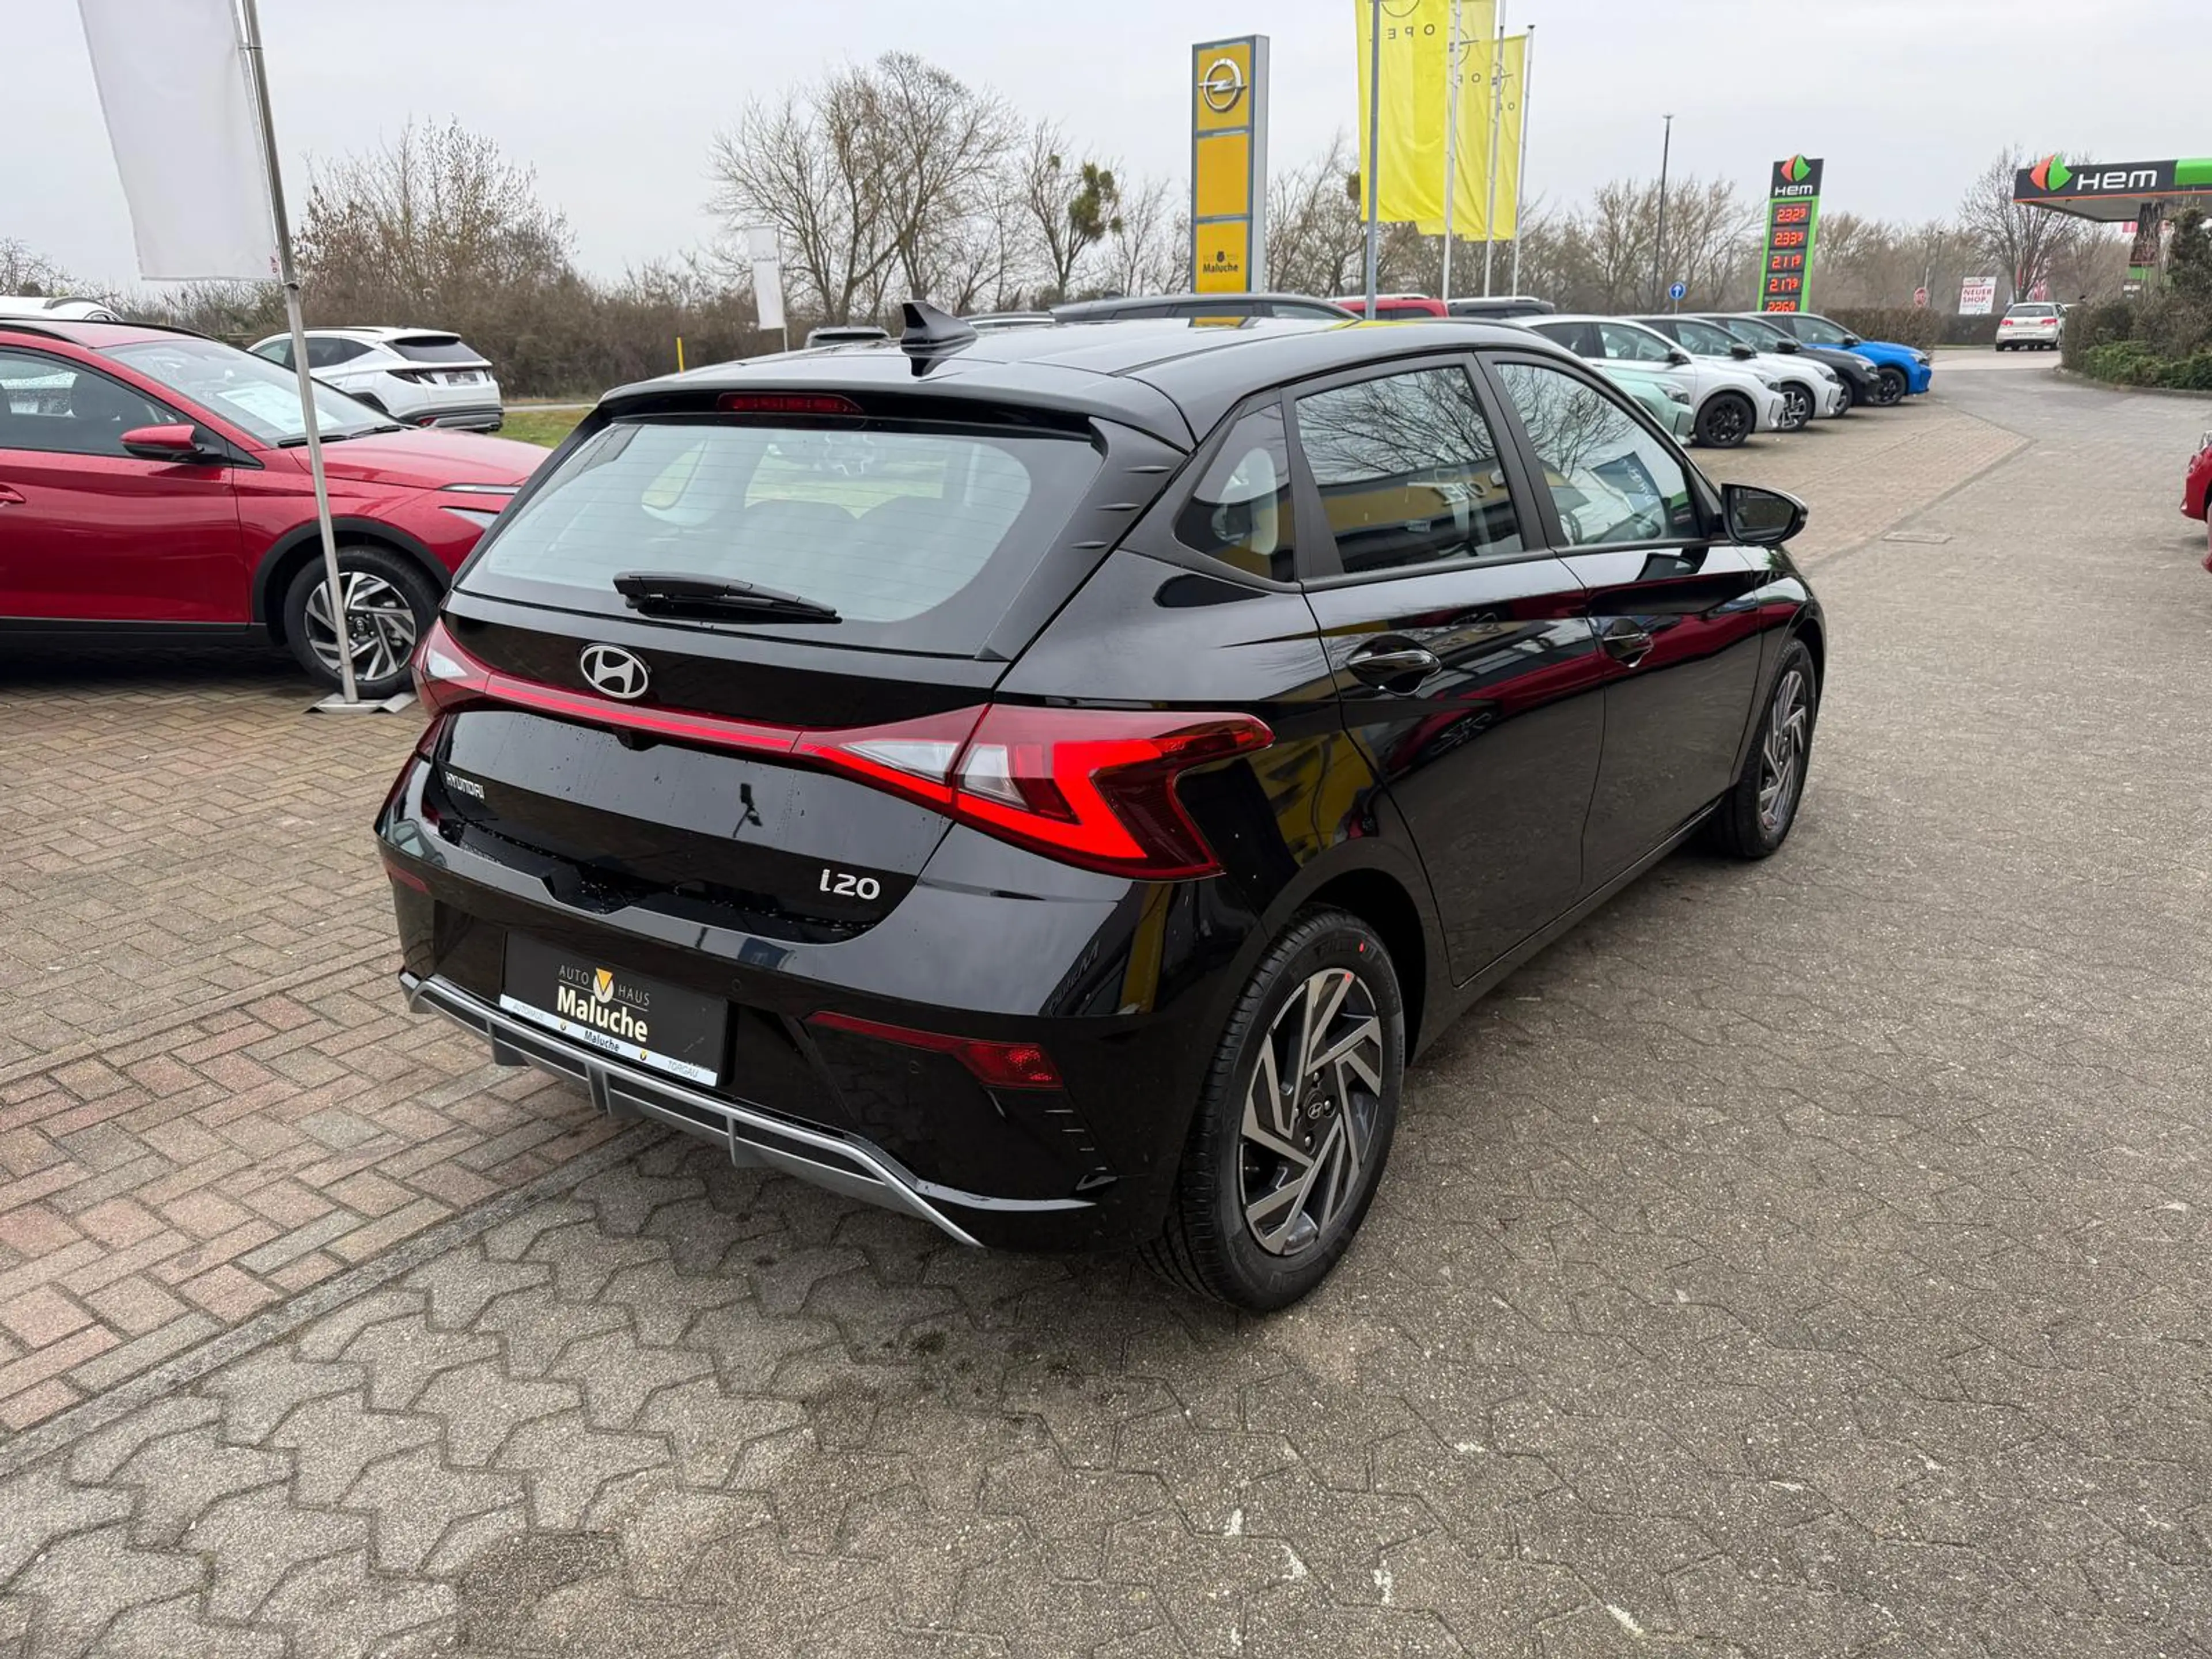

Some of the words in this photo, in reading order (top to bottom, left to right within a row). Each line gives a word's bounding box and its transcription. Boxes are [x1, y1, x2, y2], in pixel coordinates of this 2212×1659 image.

[445, 771, 485, 800] HYUNDAI
[559, 964, 589, 984] AUTO
[618, 987, 650, 1006] HAUS
[556, 986, 649, 1043] Maluche
[584, 1030, 620, 1052] Maluche
[667, 1060, 699, 1078] TORGAU
